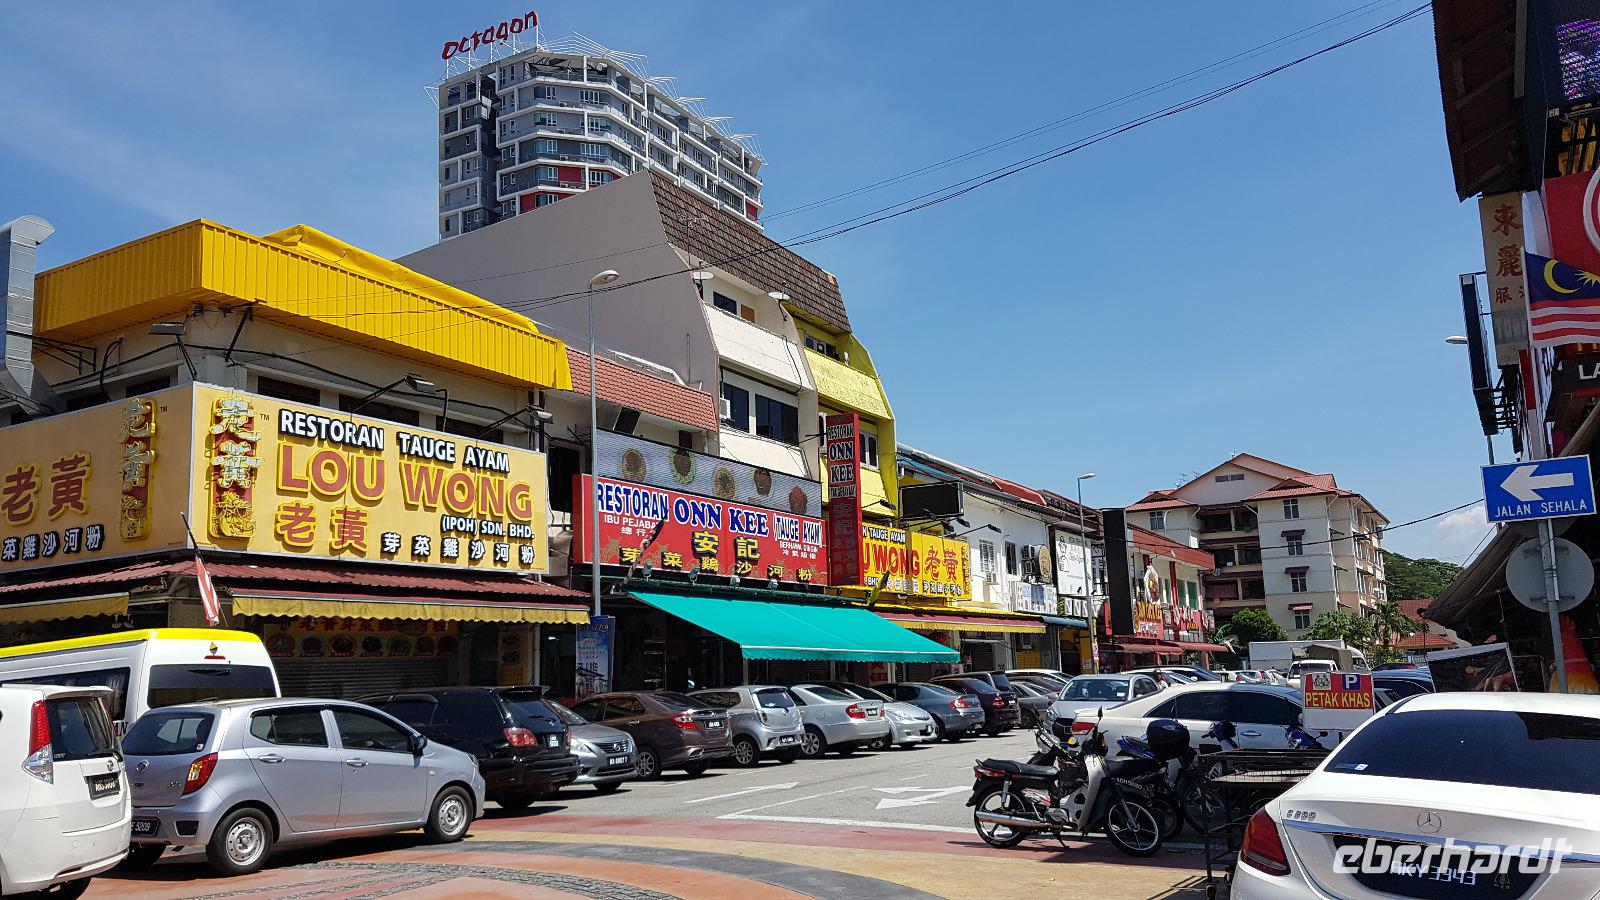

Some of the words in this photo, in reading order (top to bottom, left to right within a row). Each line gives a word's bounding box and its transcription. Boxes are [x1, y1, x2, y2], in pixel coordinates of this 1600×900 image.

[260, 413, 270, 421] TM
[279, 410, 384, 450] RESTORAN
[398, 432, 456, 463] TAUGE
[463, 445, 511, 473] AYAM
[829, 441, 853, 461] ONN
[279, 443, 386, 500] LOU
[400, 461, 535, 520] WONG
[830, 463, 853, 483] KEE
[1, 453, 87, 522] 老黃
[598, 482, 669, 522] RESTORAN
[674, 497, 722, 530] ONN
[729, 507, 769, 537] KEE
[1495, 503, 1532, 518] JALAN
[1540, 498, 1588, 514] SEHALA
[277, 502, 369, 551] 老黃
[442, 515, 478, 535] (IPOH)
[481, 520, 506, 536] SDN.
[509, 524, 535, 539] BHD.
[604, 514, 619, 525] IBU
[622, 517, 659, 530] PEJABA
[869, 527, 889, 540] TAUGE
[693, 531, 760, 559] 安記
[872, 543, 920, 577] WONG
[1345, 674, 1358, 689] P
[1305, 692, 1340, 707] PETAK
[1341, 692, 1371, 708] KHAS
